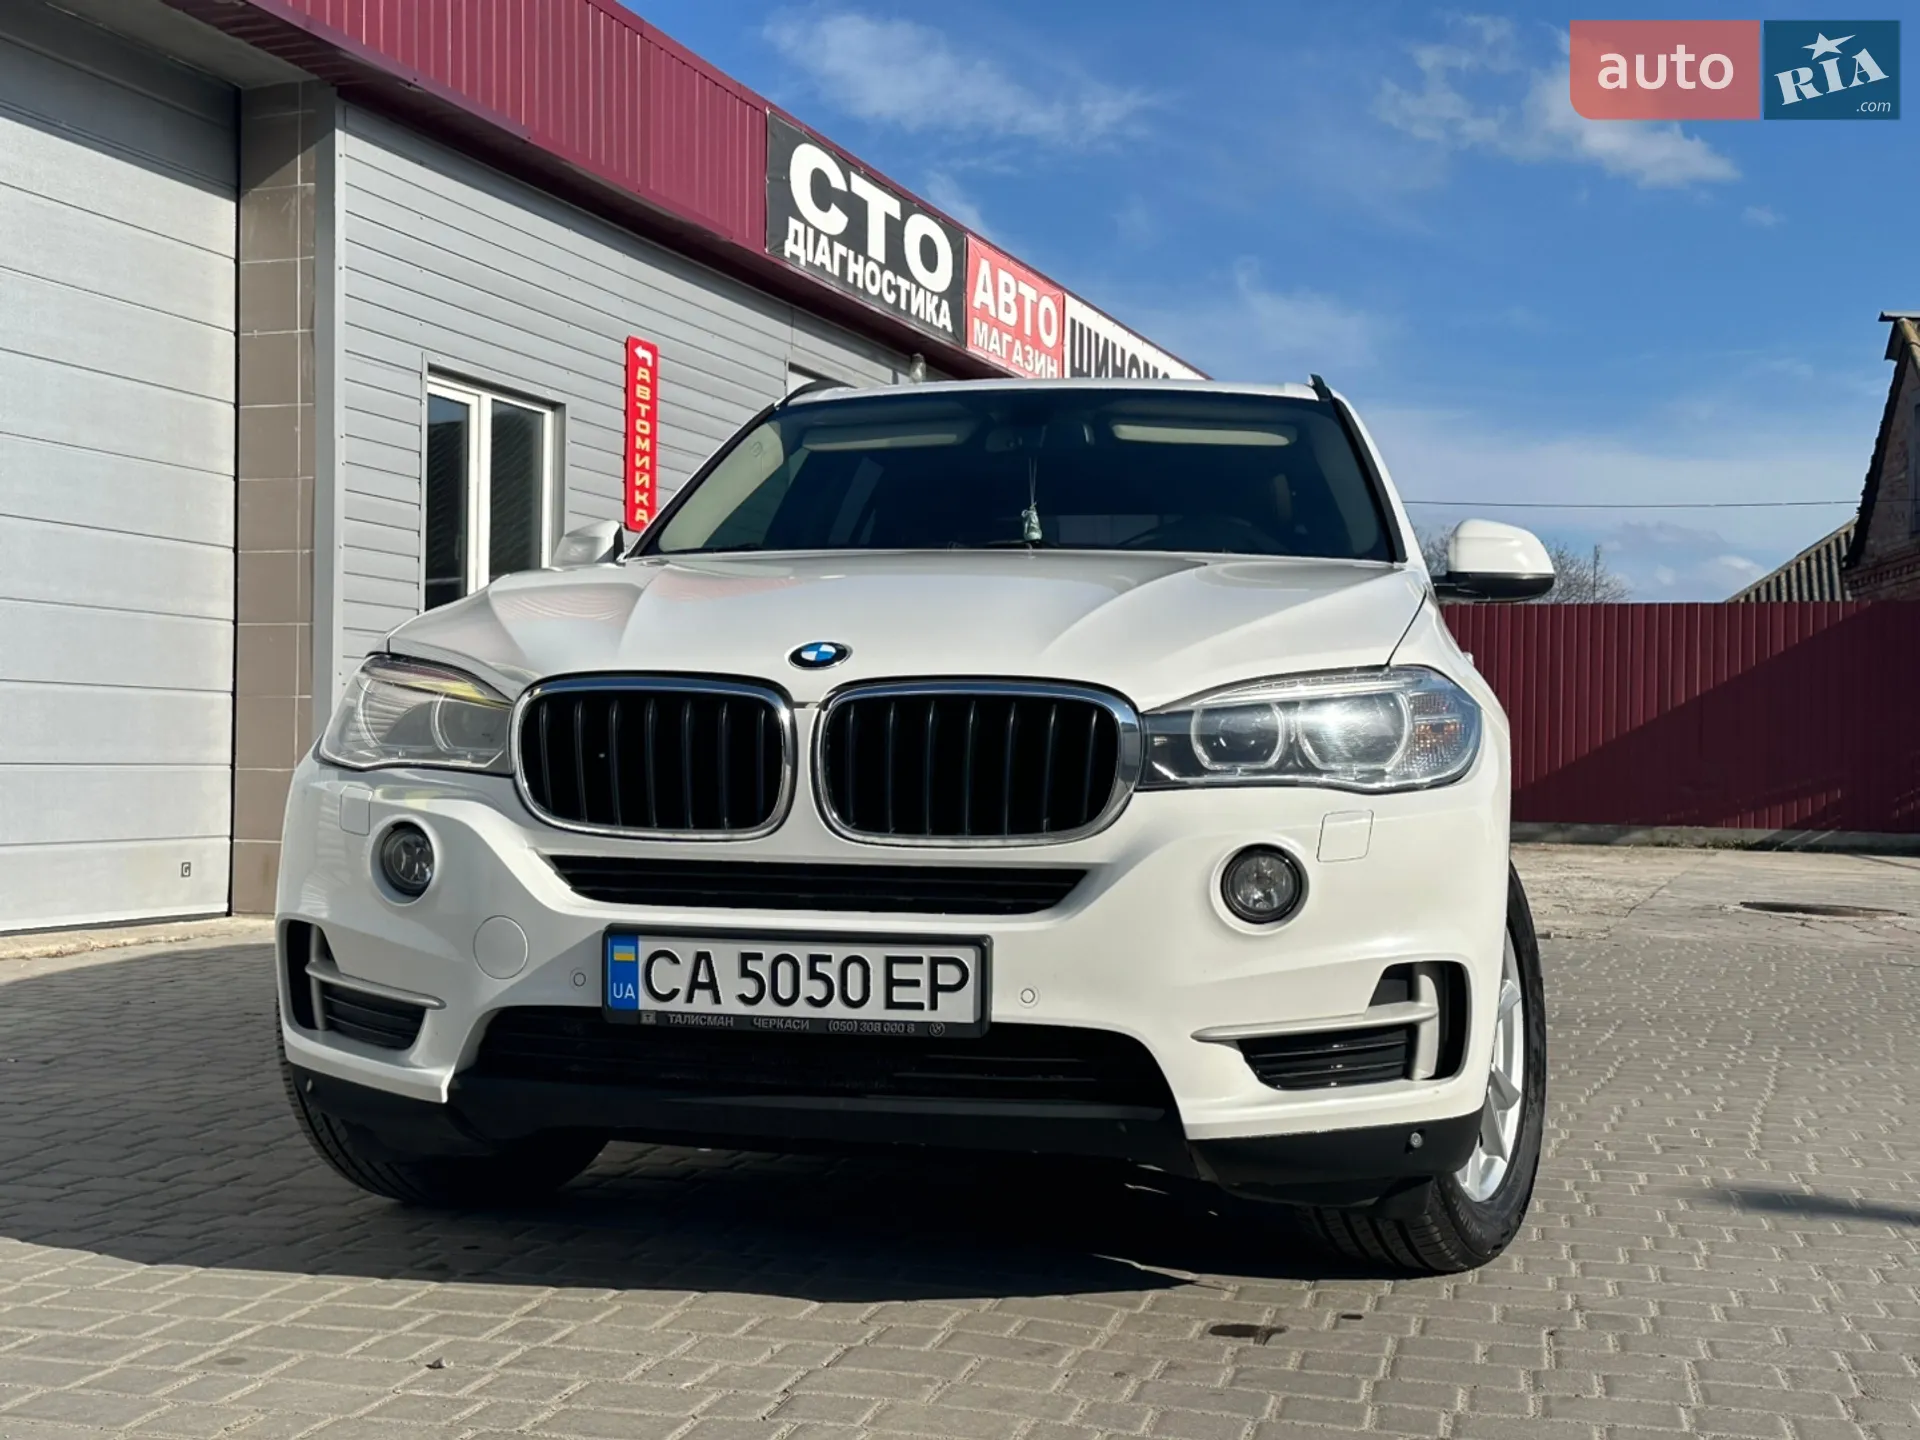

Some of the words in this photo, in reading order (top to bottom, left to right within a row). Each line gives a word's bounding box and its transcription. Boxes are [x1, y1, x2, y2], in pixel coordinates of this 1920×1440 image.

[789, 143, 953, 293] СТО
[784, 216, 953, 333] ДІАГНОСТИКА
[972, 257, 1059, 349] АВТО
[973, 317, 1059, 379] МАГАЗИН
[1069, 316, 1171, 379] ШИН
[634, 366, 651, 524] АВТОМИЙКА
[612, 983, 636, 1000] UA
[644, 949, 722, 1005] CA
[736, 951, 872, 1008] 5050
[885, 955, 970, 1011] EP
[667, 1013, 734, 1027] ТАЛИСМАН
[752, 1017, 810, 1030] ЧЕРКАСИ
[828, 1020, 858, 1032] (050)
